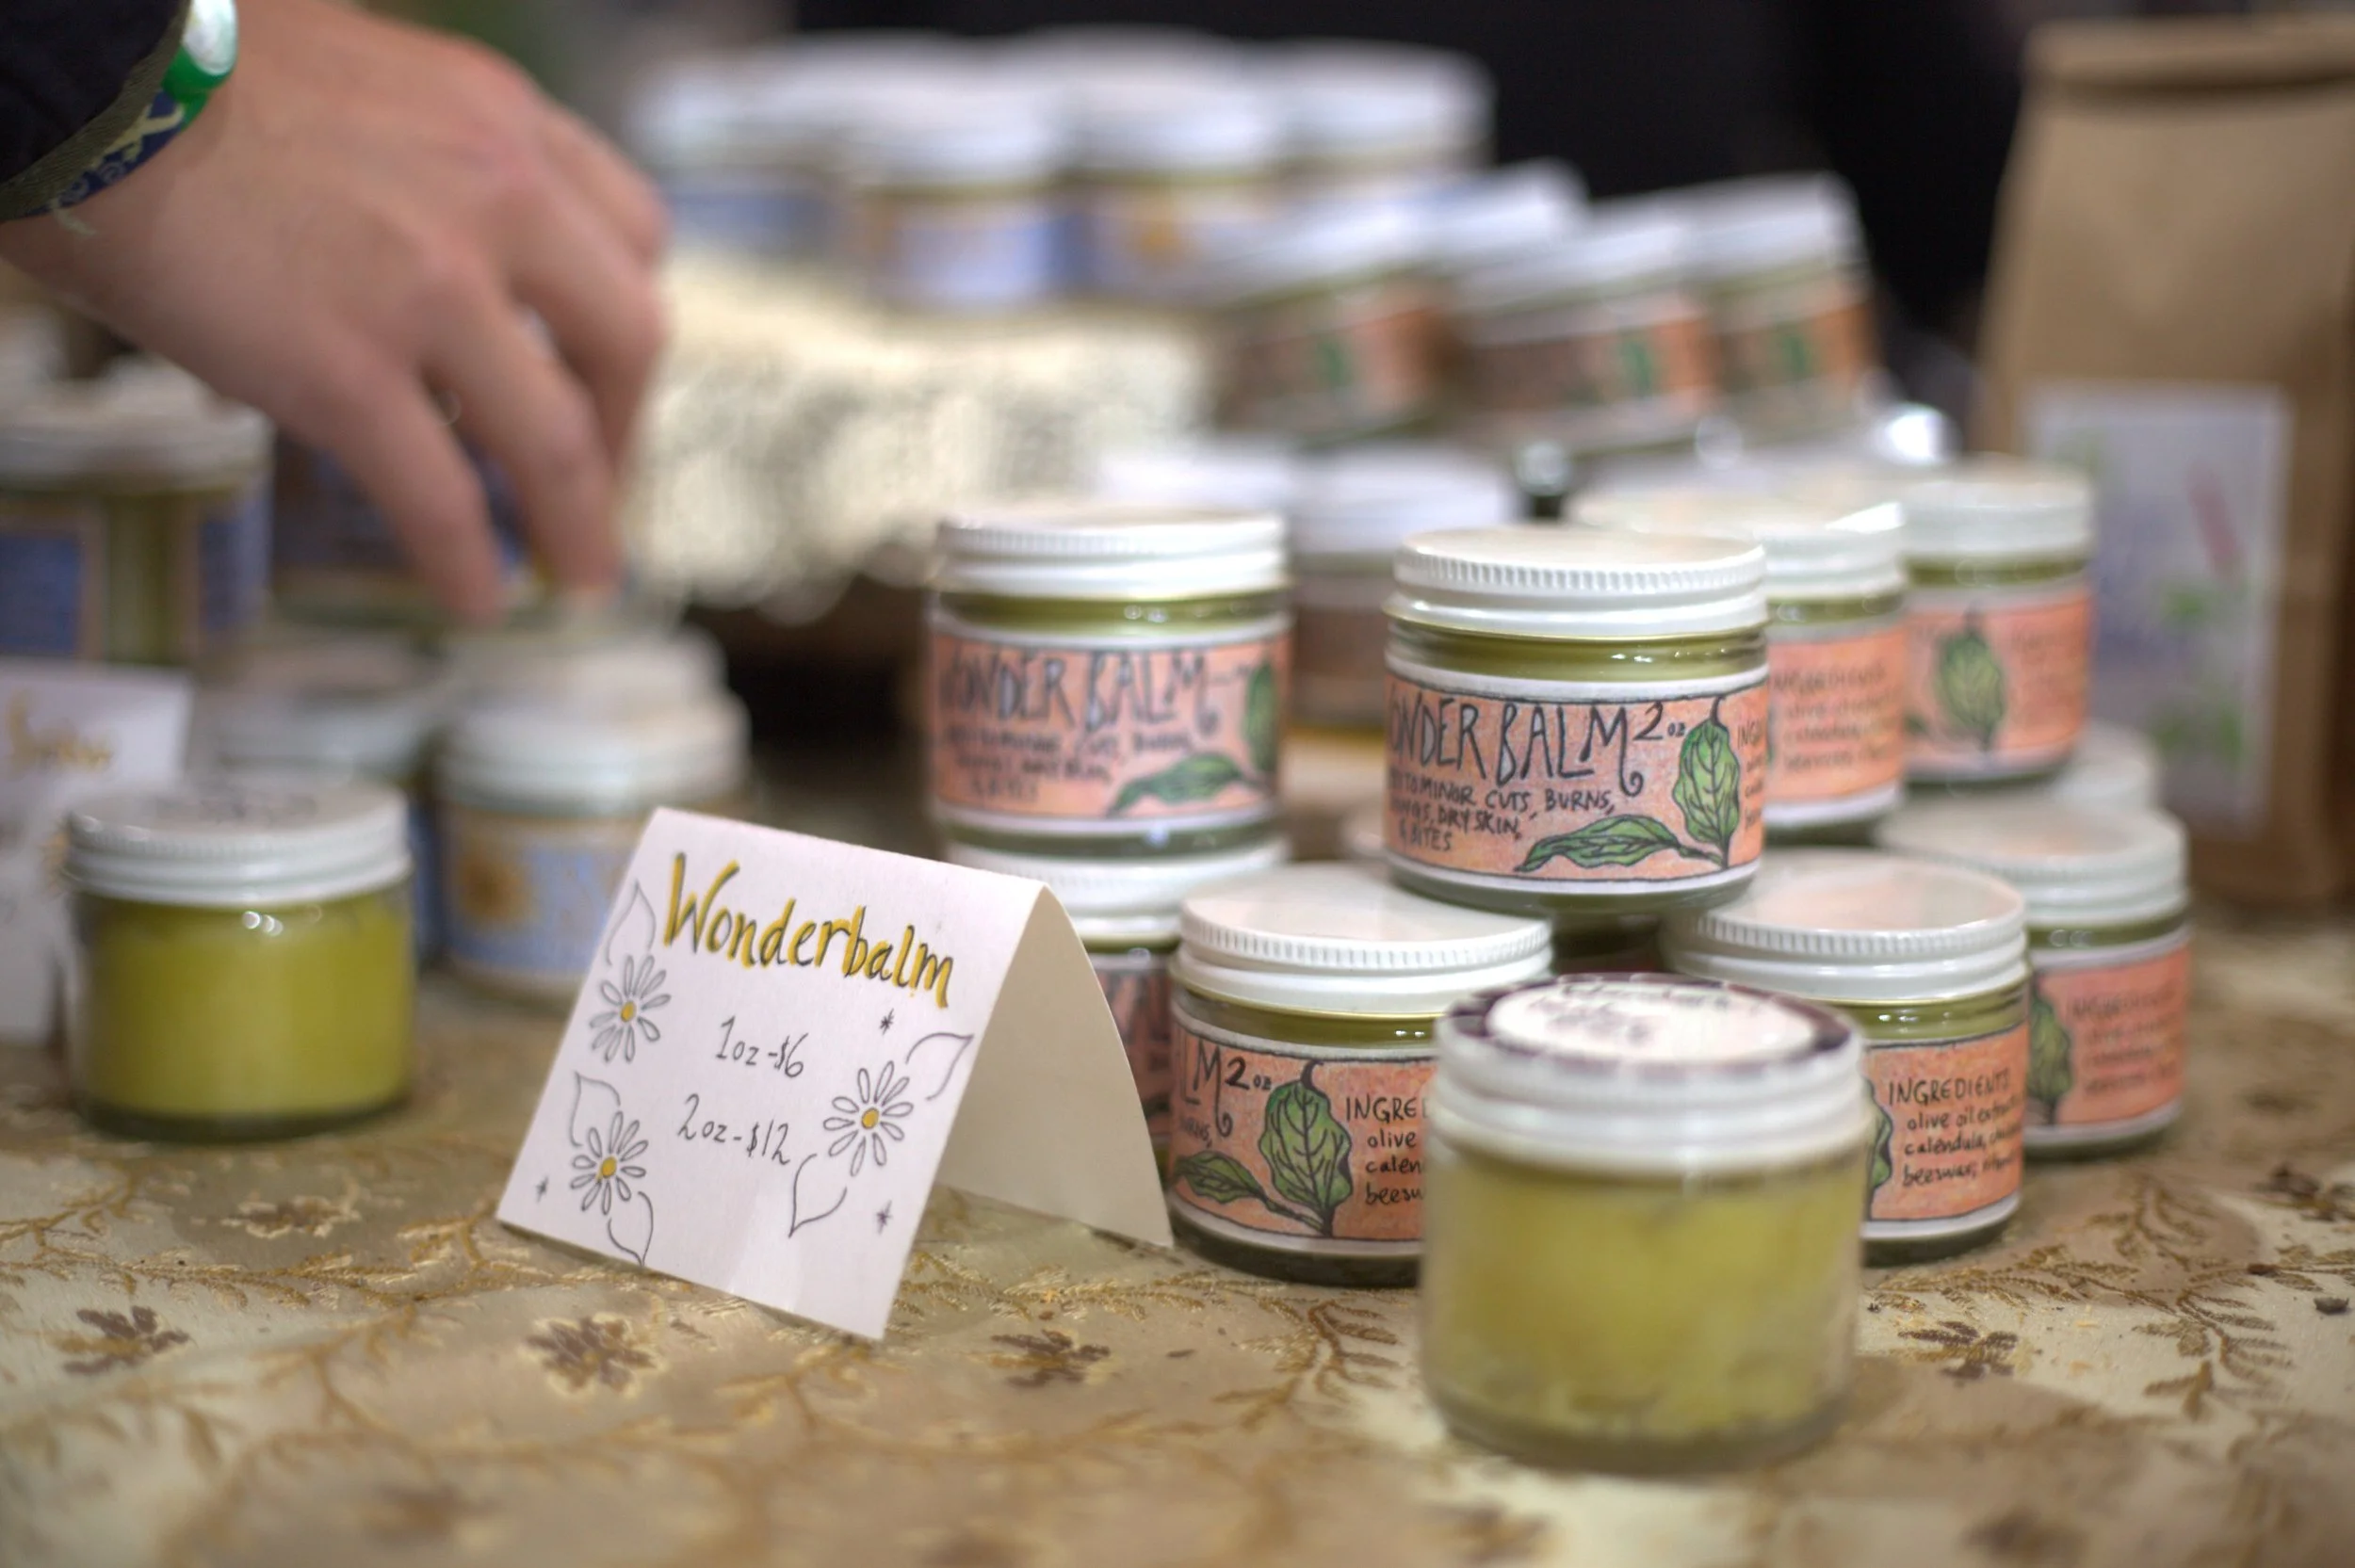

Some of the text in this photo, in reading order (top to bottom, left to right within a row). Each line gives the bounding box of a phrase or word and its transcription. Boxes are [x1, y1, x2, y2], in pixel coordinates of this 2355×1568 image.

[1496, 700, 1644, 798] BALM
[1420, 775, 1476, 807] MINOR
[1544, 788, 1616, 817] BURNS,
[1437, 804, 1470, 834] DRY
[662, 851, 954, 1008] Wonderbalm
[1888, 1067, 2009, 1107] INGREDIENTS
[1367, 1128, 1417, 1148] olive
[1907, 1111, 1950, 1131] olive
[1366, 1155, 1425, 1174] calen
